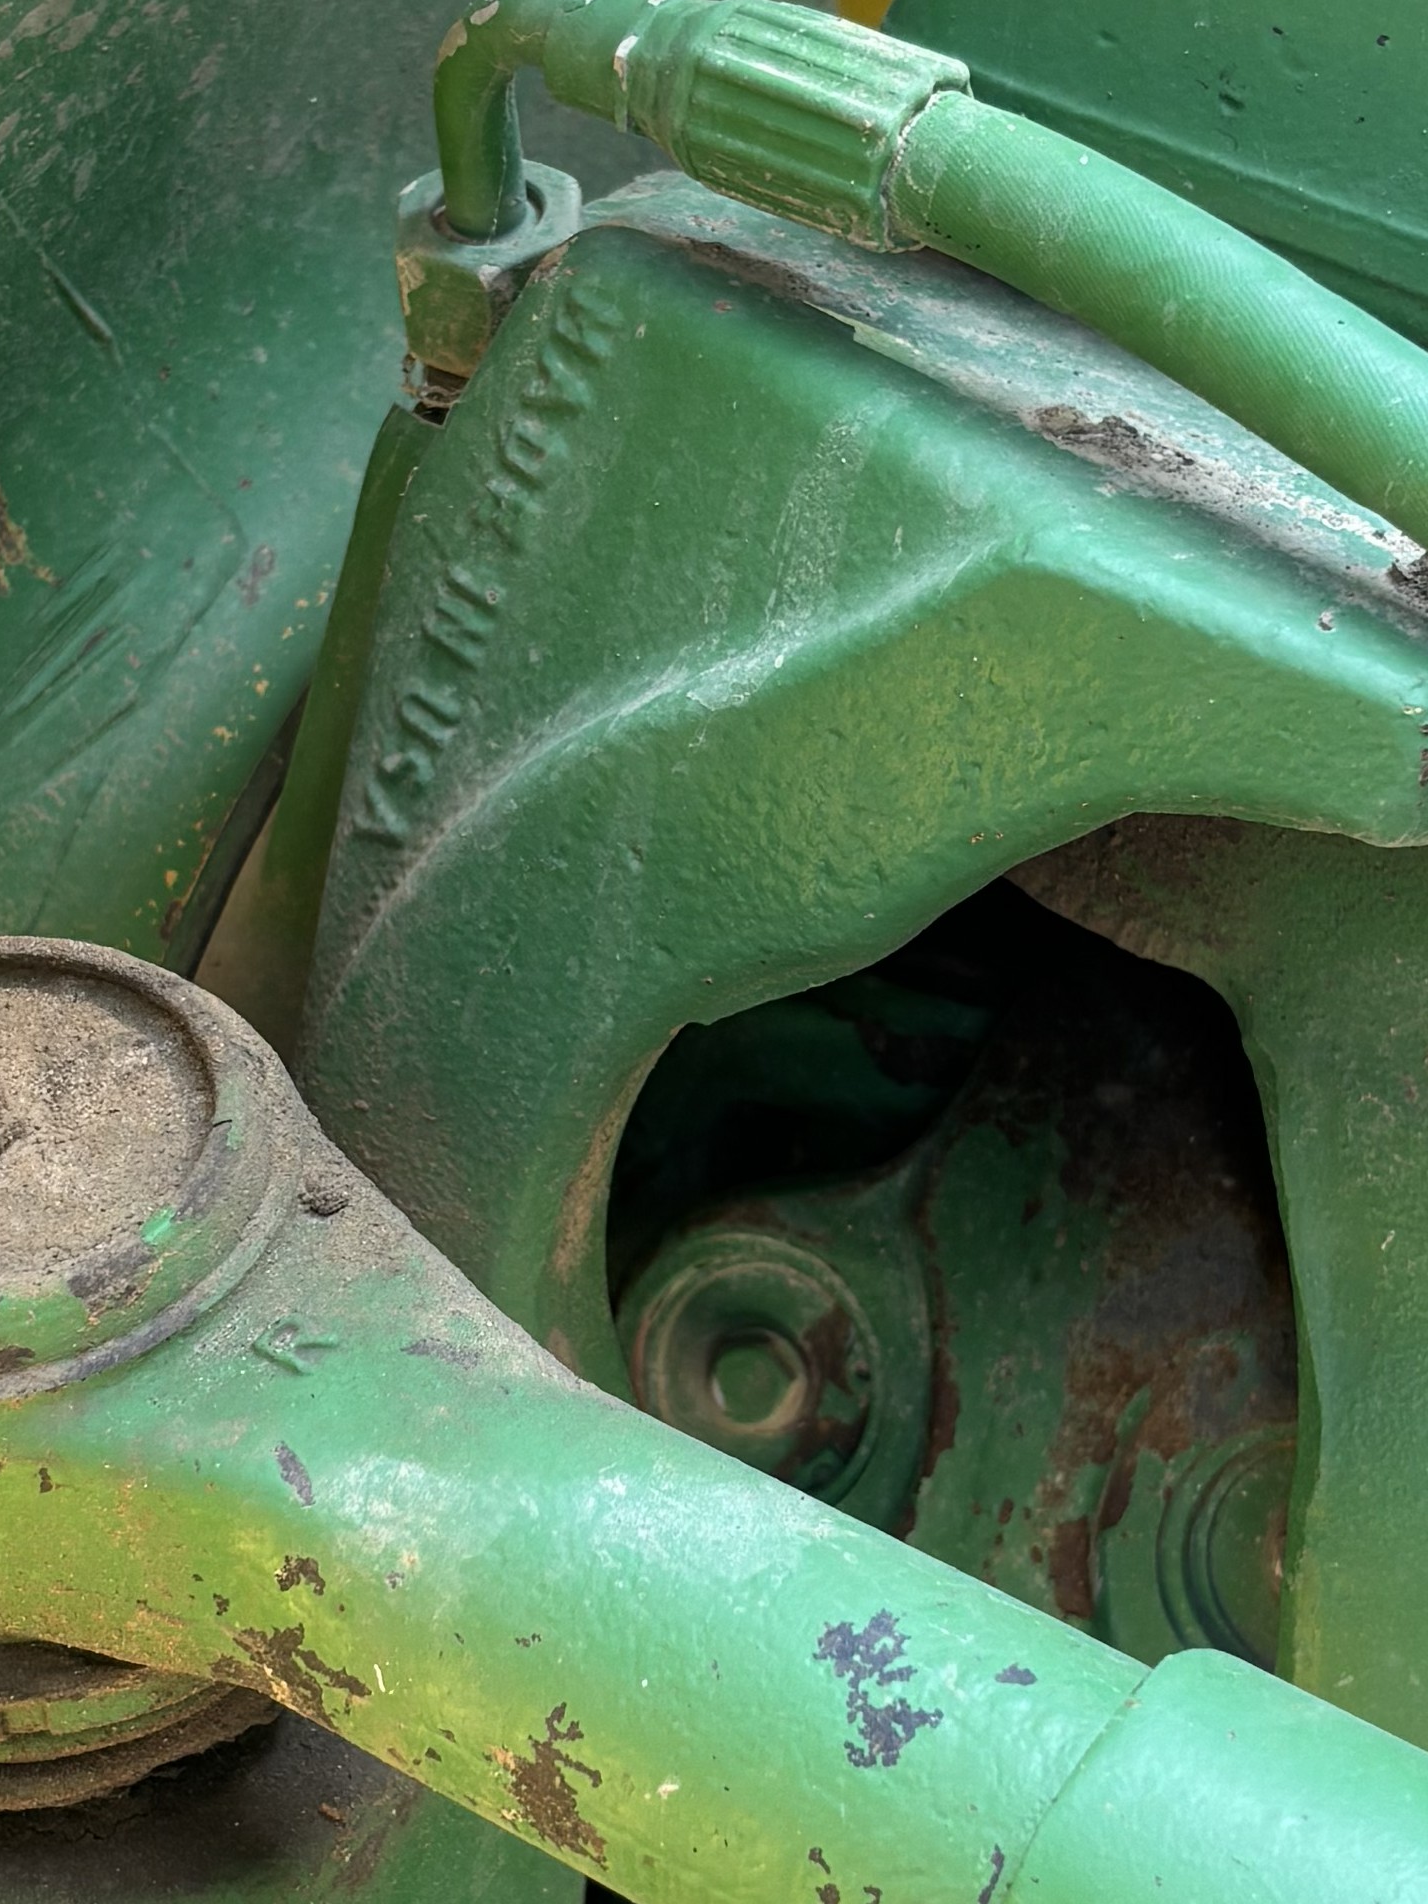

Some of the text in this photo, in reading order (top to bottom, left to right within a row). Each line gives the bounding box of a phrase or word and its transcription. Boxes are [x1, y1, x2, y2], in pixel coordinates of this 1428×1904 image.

[348, 282, 624, 848] MADE IN USA
